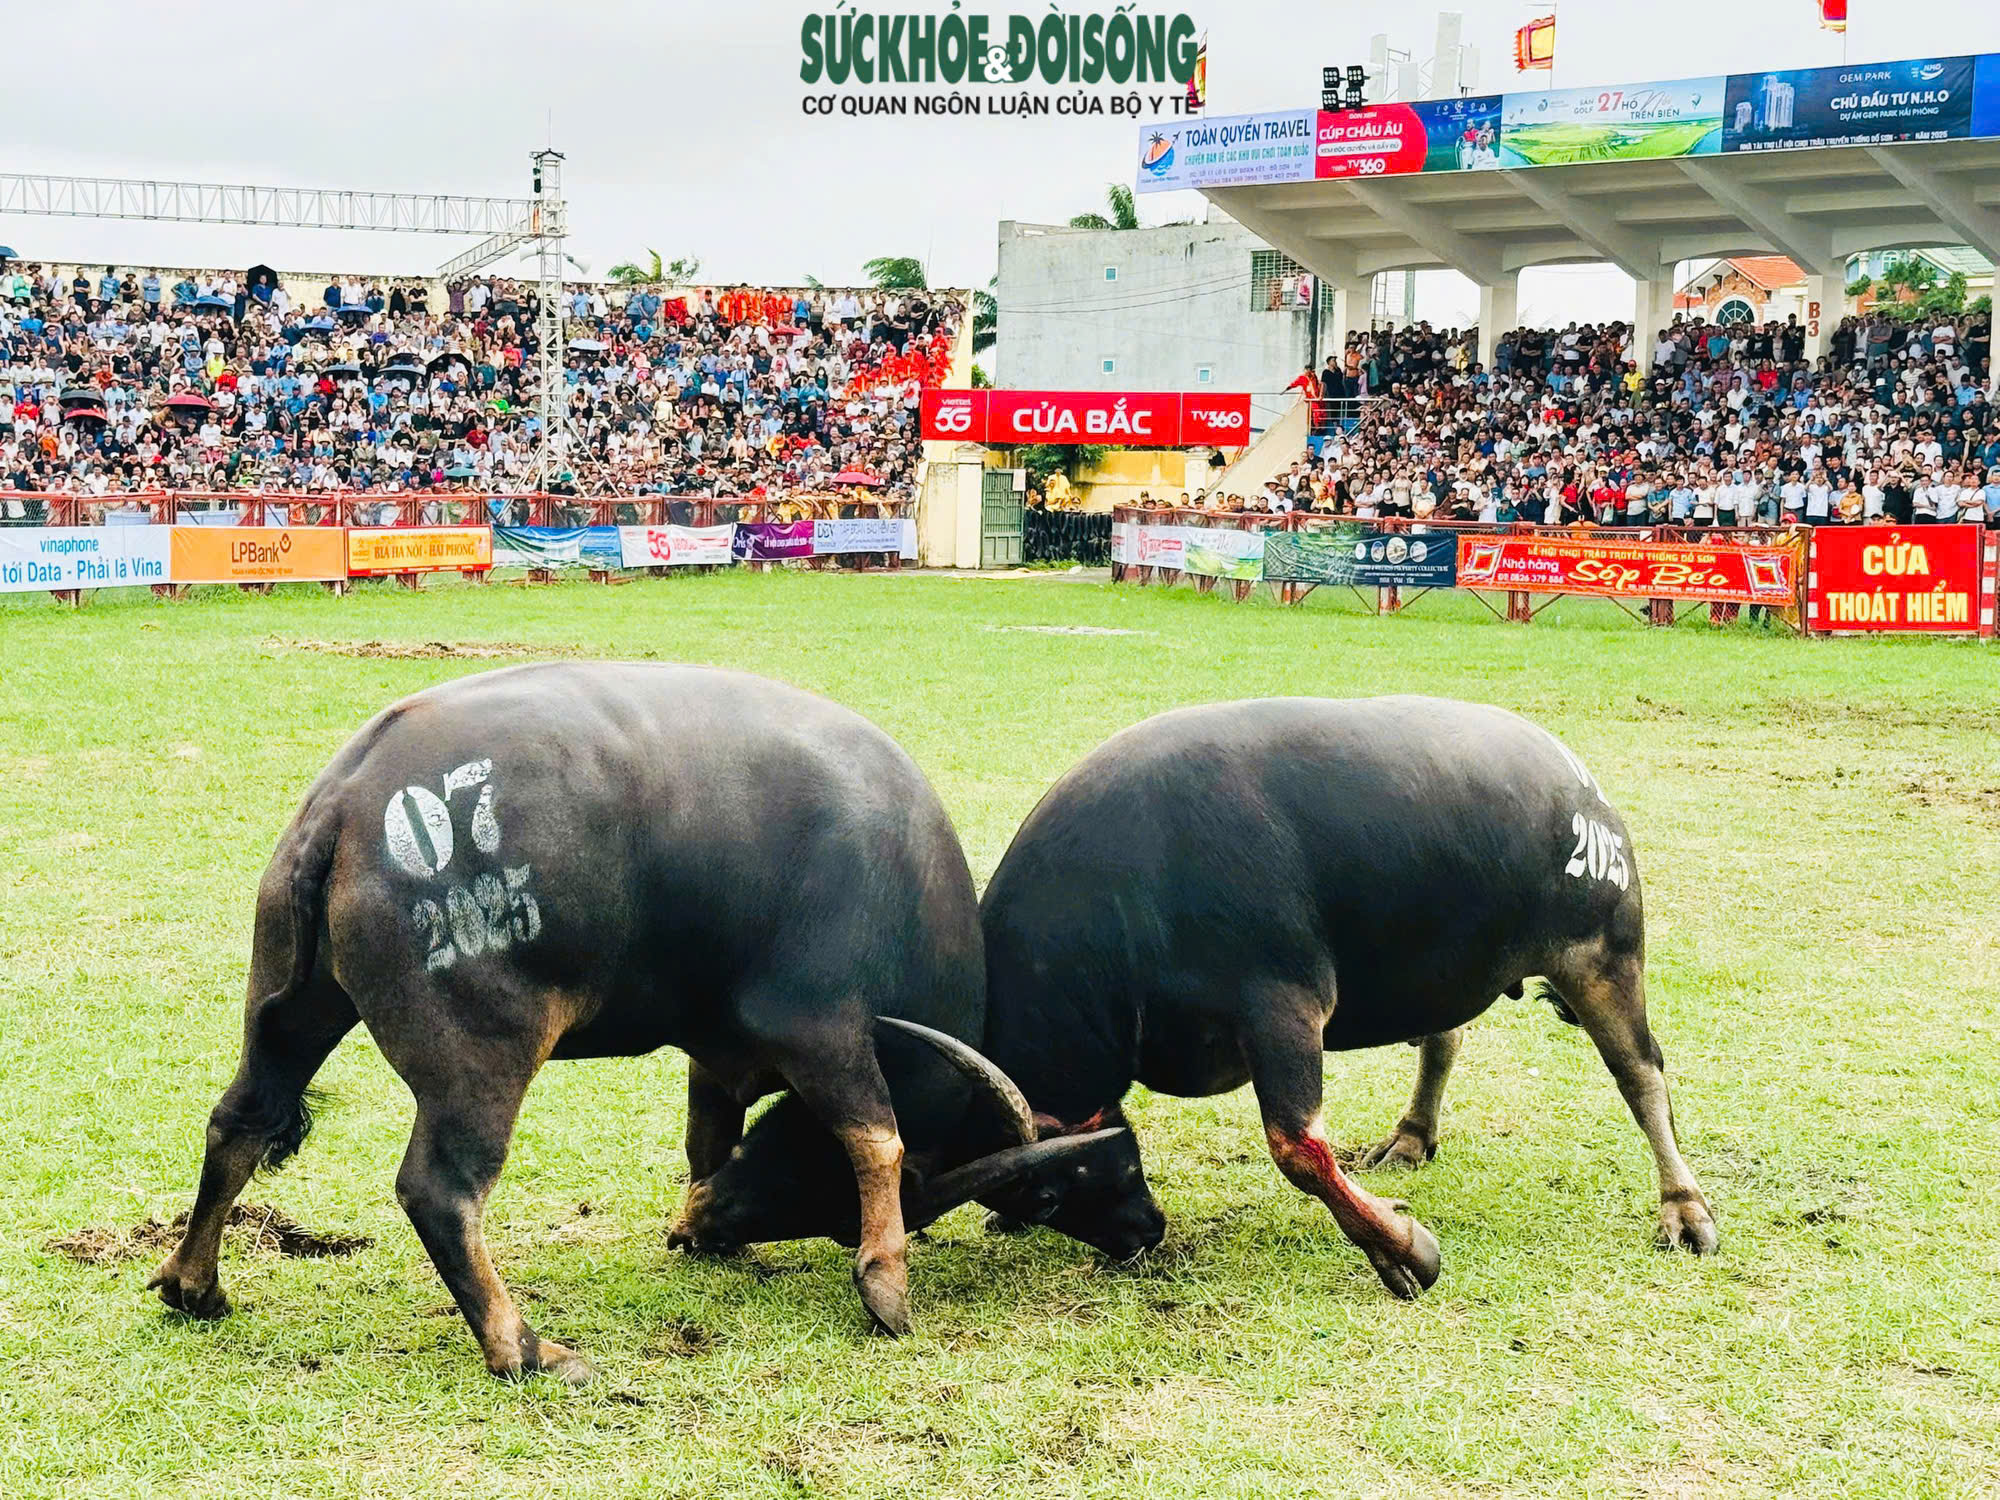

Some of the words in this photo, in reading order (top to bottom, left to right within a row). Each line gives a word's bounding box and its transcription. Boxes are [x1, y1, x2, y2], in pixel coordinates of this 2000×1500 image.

[1839, 73, 1862, 83] GEM
[1865, 71, 1892, 81] PARK
[1598, 91, 1624, 112] 27
[1830, 92, 1859, 110] CHỦ
[1861, 89, 1889, 108] ĐẦU
[1891, 91, 1909, 105] TƯ
[1911, 89, 1949, 105] N.H.O
[1574, 106, 1593, 115] GOLF
[1630, 110, 1655, 121] TRÊN
[1840, 112, 1851, 122] DỰ
[1852, 110, 1862, 120] ÁN
[1862, 110, 1879, 119] GEM
[1880, 109, 1898, 118] PARK
[1898, 107, 1911, 117] HẢI
[1912, 106, 1940, 116] PHÒNG
[1186, 124, 1218, 147] TOÀN
[1264, 119, 1311, 140] TRAVEL
[1319, 125, 1345, 140] CÚP
[1346, 122, 1382, 138] CHÂU
[1384, 120, 1403, 136] ÂU
[1347, 158, 1386, 174] TV360
[1808, 301, 1821, 319] B
[1808, 320, 1820, 337] 3
[941, 397, 972, 405] viettel
[934, 406, 972, 432] 5G
[1012, 401, 1079, 434] CỬA
[1086, 397, 1152, 434] BẮC
[1191, 410, 1244, 428] TV360
[40, 536, 99, 555] vinaphone
[231, 541, 280, 563] LPBank
[1863, 532, 1929, 576] CỬA
[2, 561, 22, 583] tới
[28, 561, 62, 582] Data
[77, 555, 110, 580] Phải
[115, 557, 127, 579] là
[132, 557, 163, 577] Vina
[1648, 563, 1729, 586] Béo
[1826, 585, 1899, 622] THOÁT
[1906, 579, 1968, 622] HIỂM
[384, 758, 500, 880] 07
[1565, 811, 1629, 892] 2025
